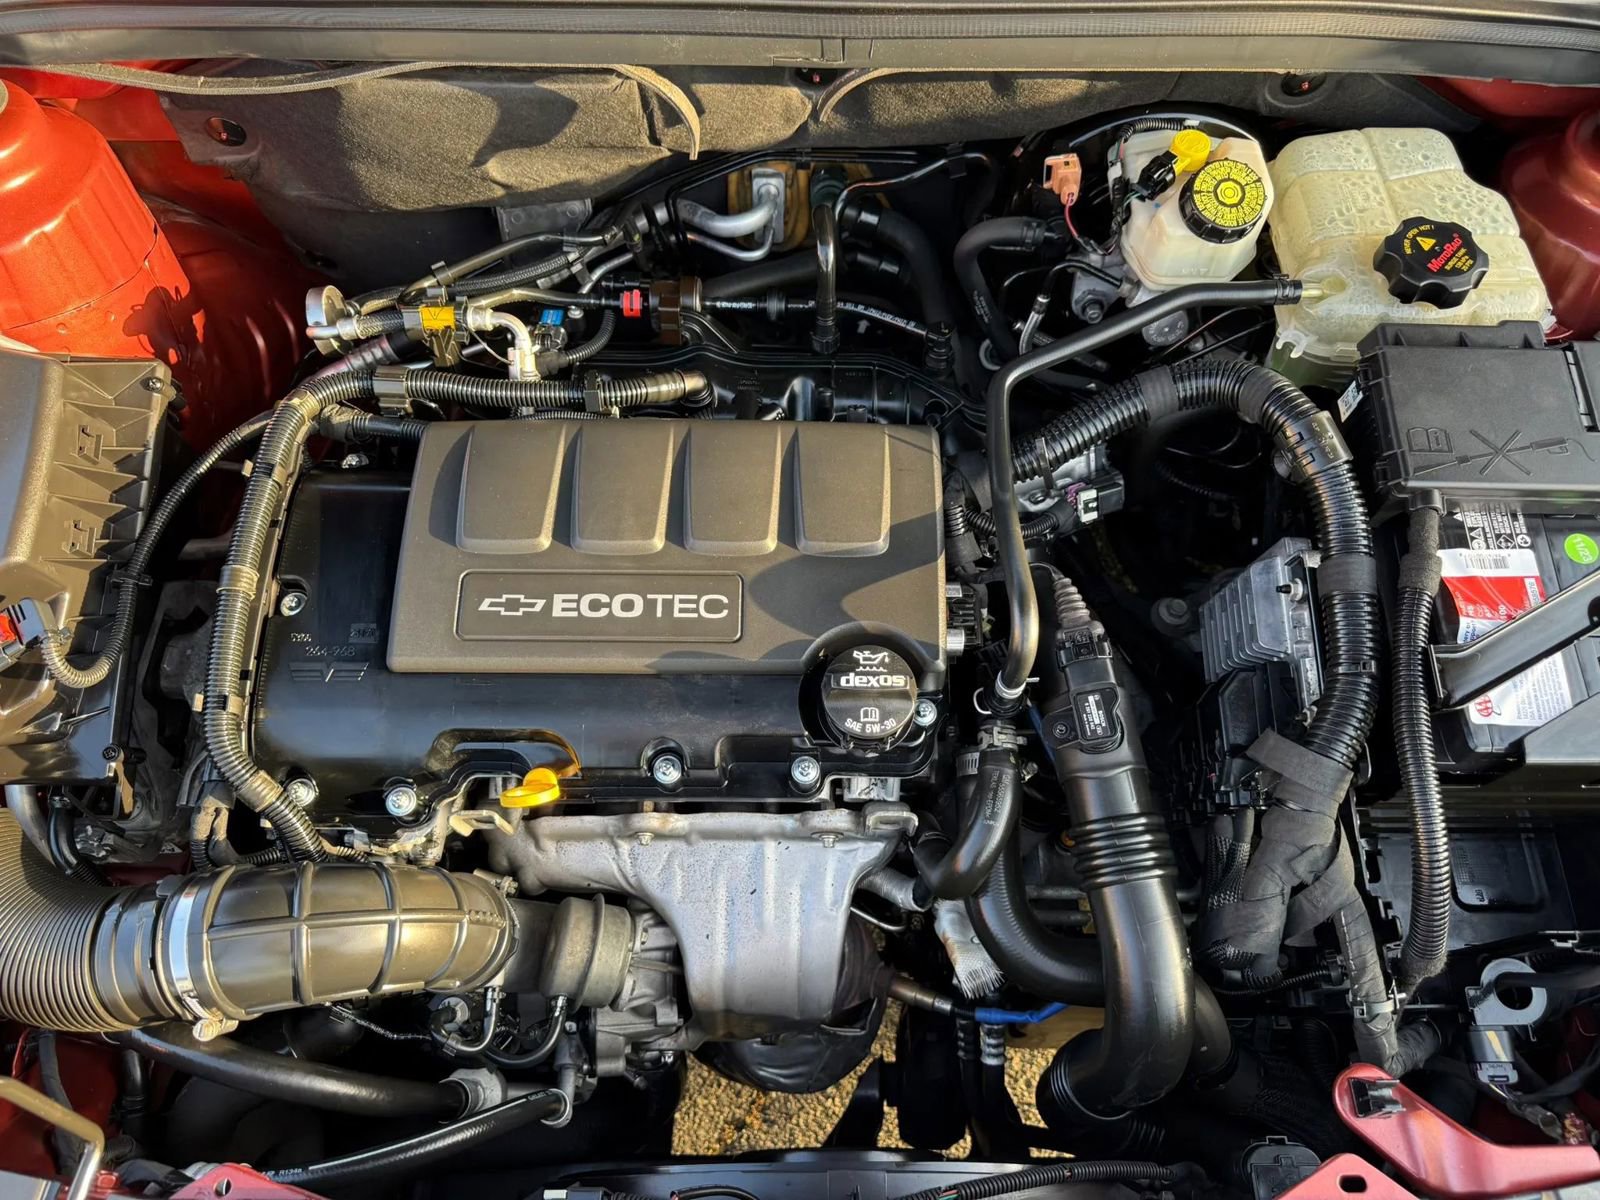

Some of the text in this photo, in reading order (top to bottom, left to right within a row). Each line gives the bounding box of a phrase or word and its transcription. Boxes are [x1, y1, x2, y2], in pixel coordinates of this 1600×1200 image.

[1406, 228, 1420, 240] OPEN
[1573, 537, 1592, 564] 11/23
[552, 594, 728, 618] ECOTEC
[840, 673, 905, 687] dexos
[844, 718, 897, 733] SAE 5W-30
[278, 1167, 302, 1176] R134a
